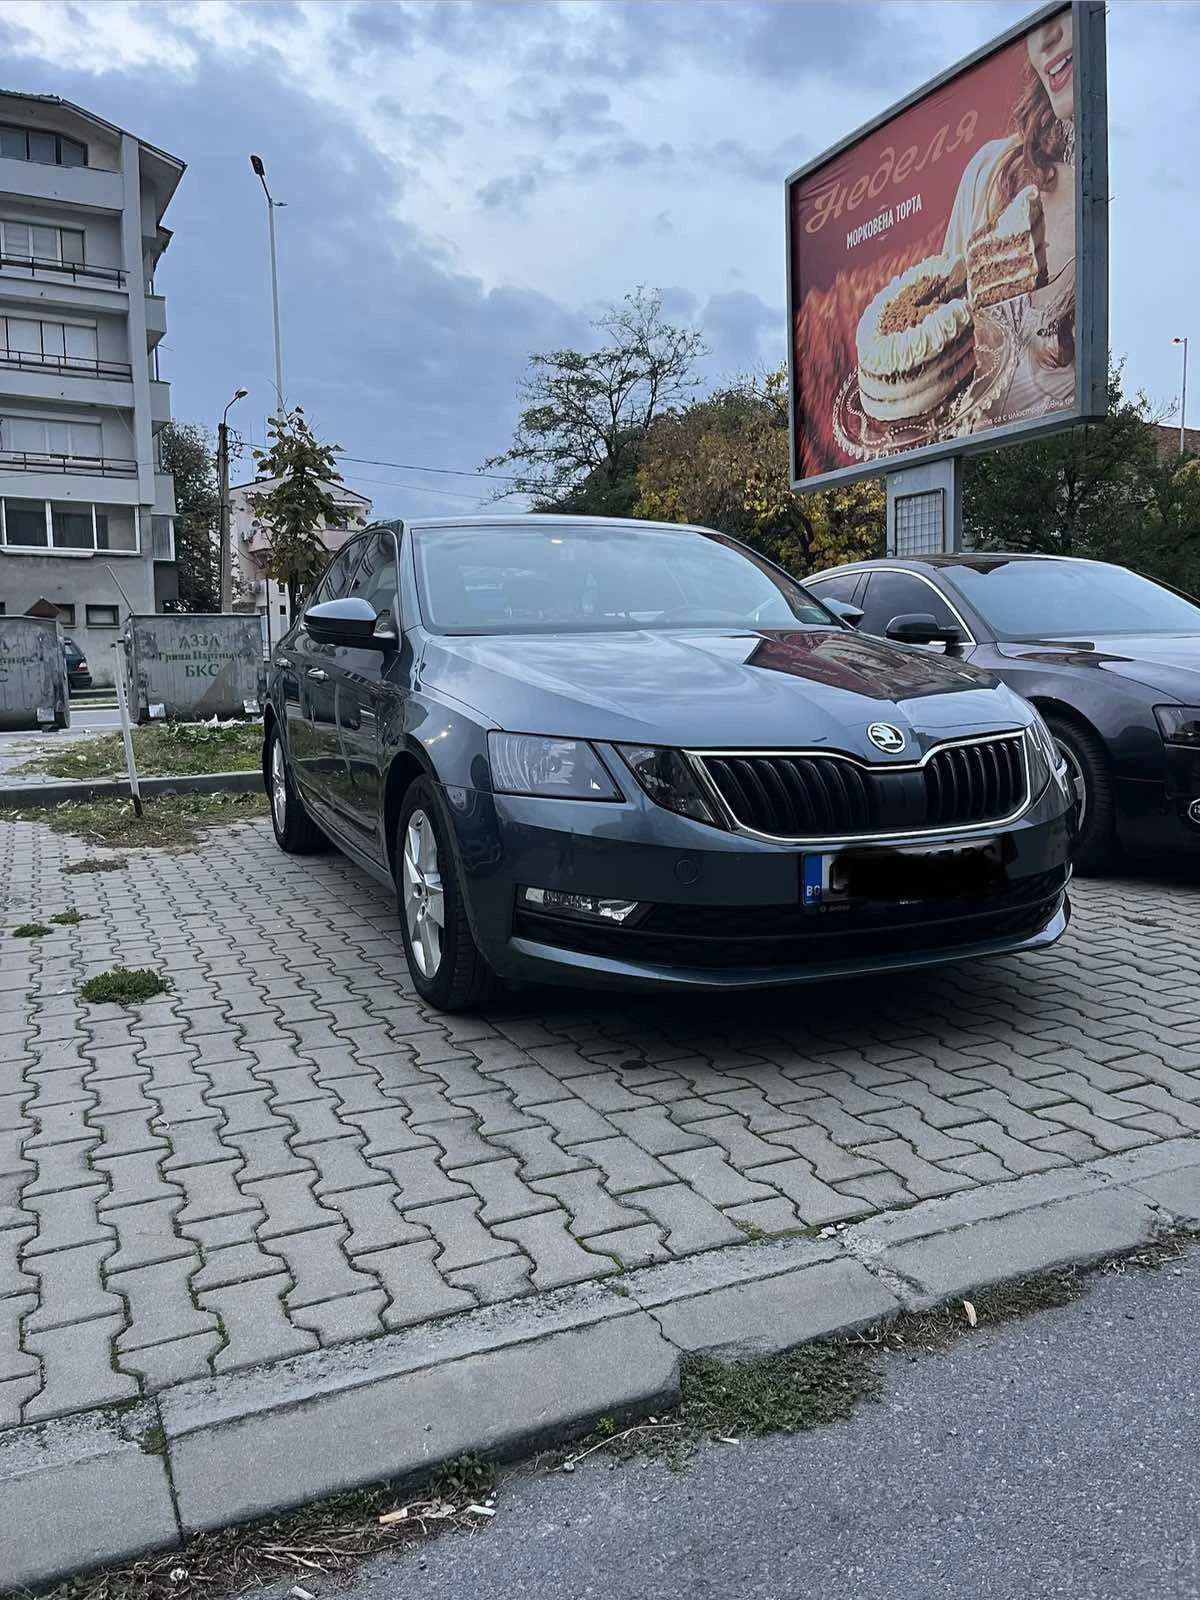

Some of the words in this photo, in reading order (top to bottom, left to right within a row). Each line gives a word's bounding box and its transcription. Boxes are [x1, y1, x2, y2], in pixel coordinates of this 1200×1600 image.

[805, 110, 978, 234] Неделя
[846, 209, 895, 250] МОРКОВЕНА
[896, 194, 923, 224] ТОРТА
[185, 664, 220, 678] БКС
